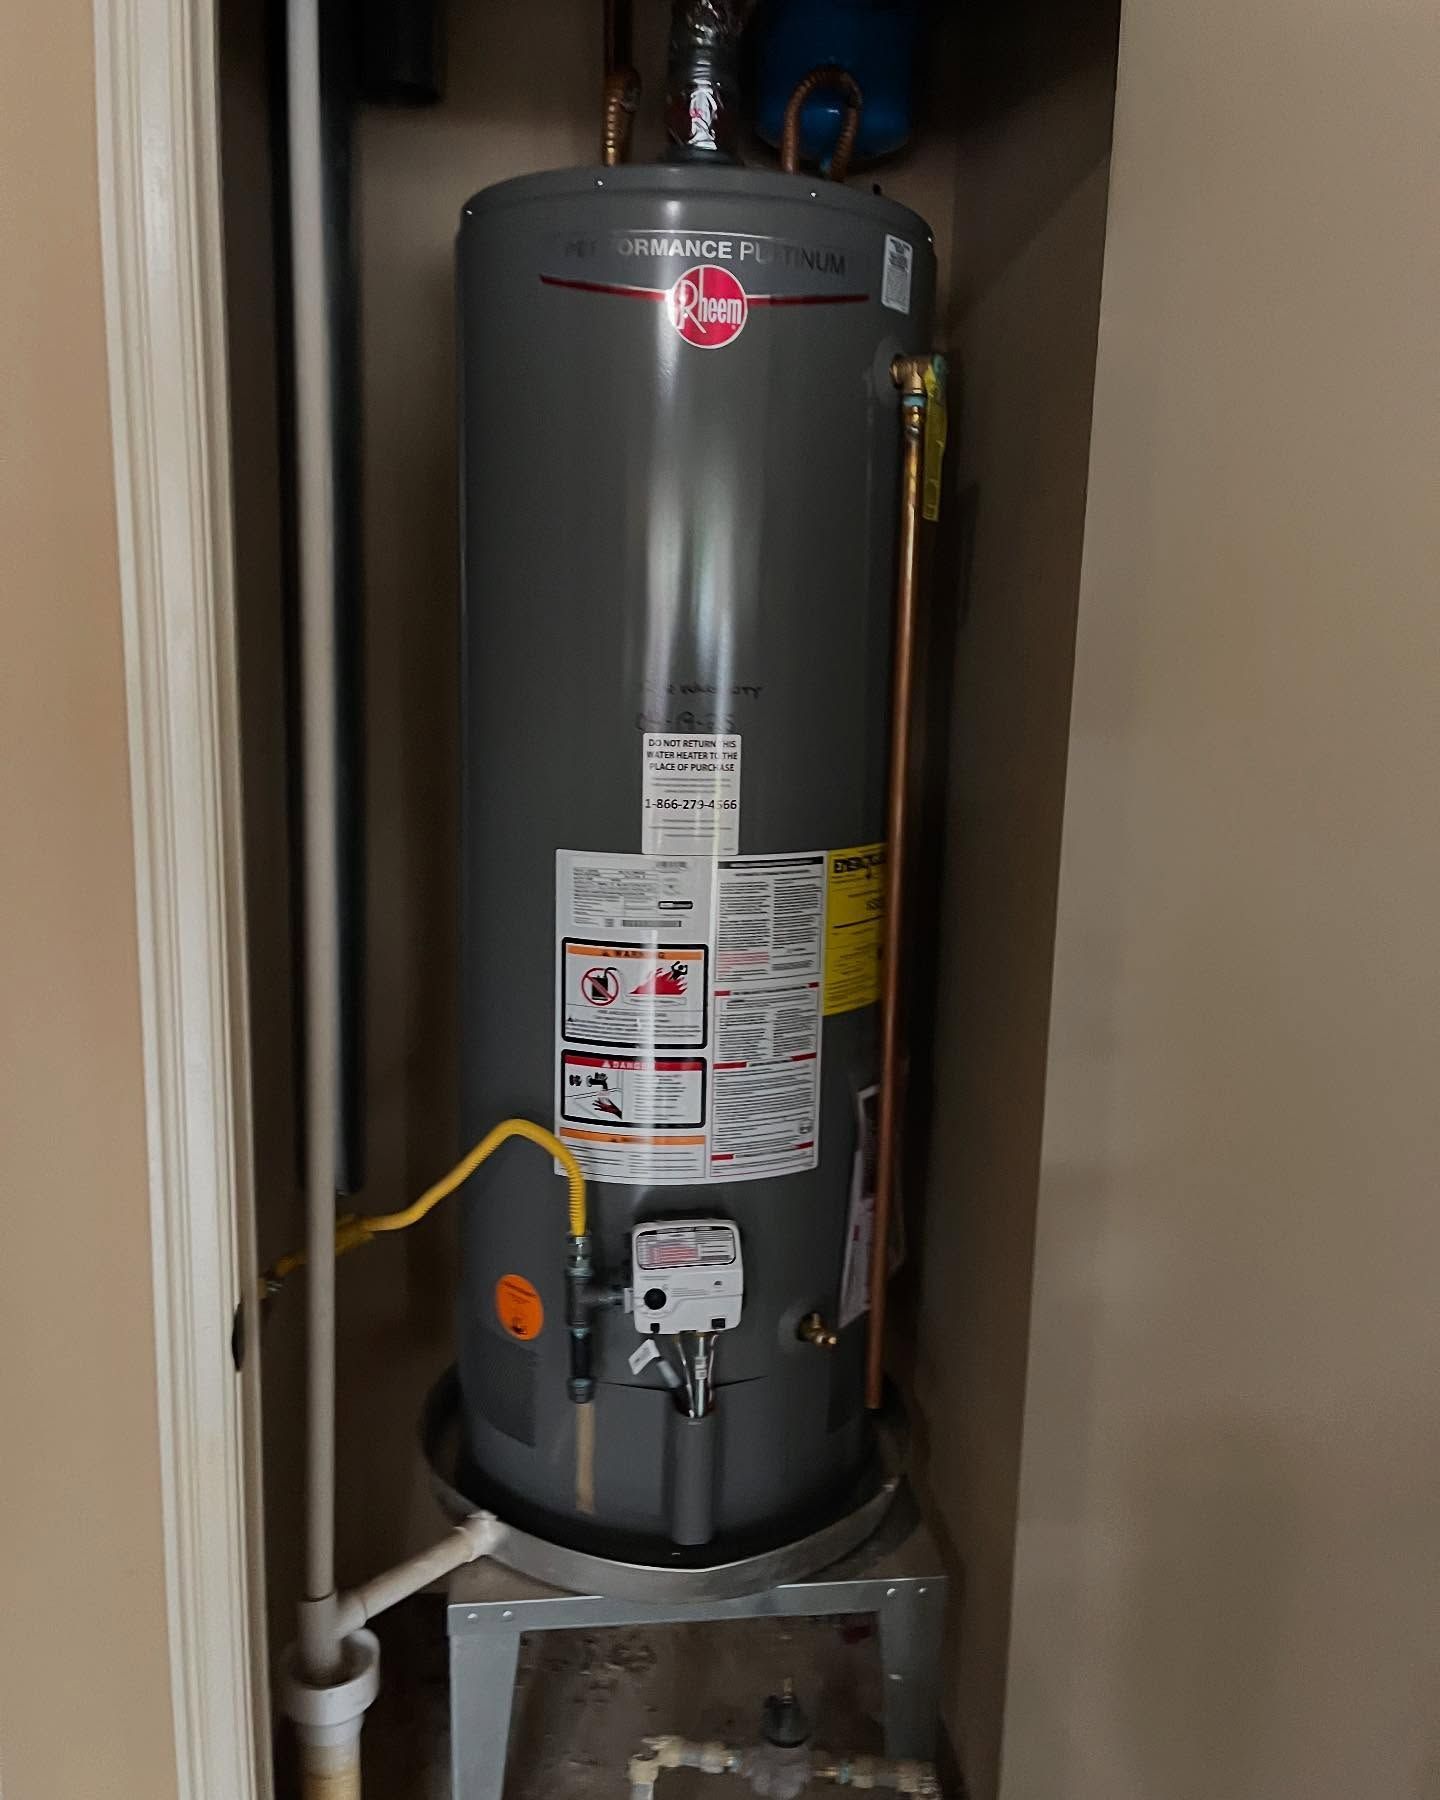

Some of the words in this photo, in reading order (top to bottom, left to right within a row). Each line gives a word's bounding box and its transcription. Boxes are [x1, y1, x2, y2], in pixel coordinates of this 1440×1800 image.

[563, 238, 732, 260] PERORMANCE
[674, 266, 742, 333] Rheem
[648, 739, 662, 747] DO
[683, 740, 716, 748] RETURN
[718, 740, 736, 748] HIS
[647, 751, 675, 759] WATER
[676, 752, 708, 760] HEATER
[722, 752, 738, 760] THE
[649, 763, 675, 771] PLACE
[677, 763, 689, 771] OF
[691, 763, 735, 772] PURCHASE
[645, 798, 737, 810] 1-866-279-4566
[615, 949, 665, 959] WARG
